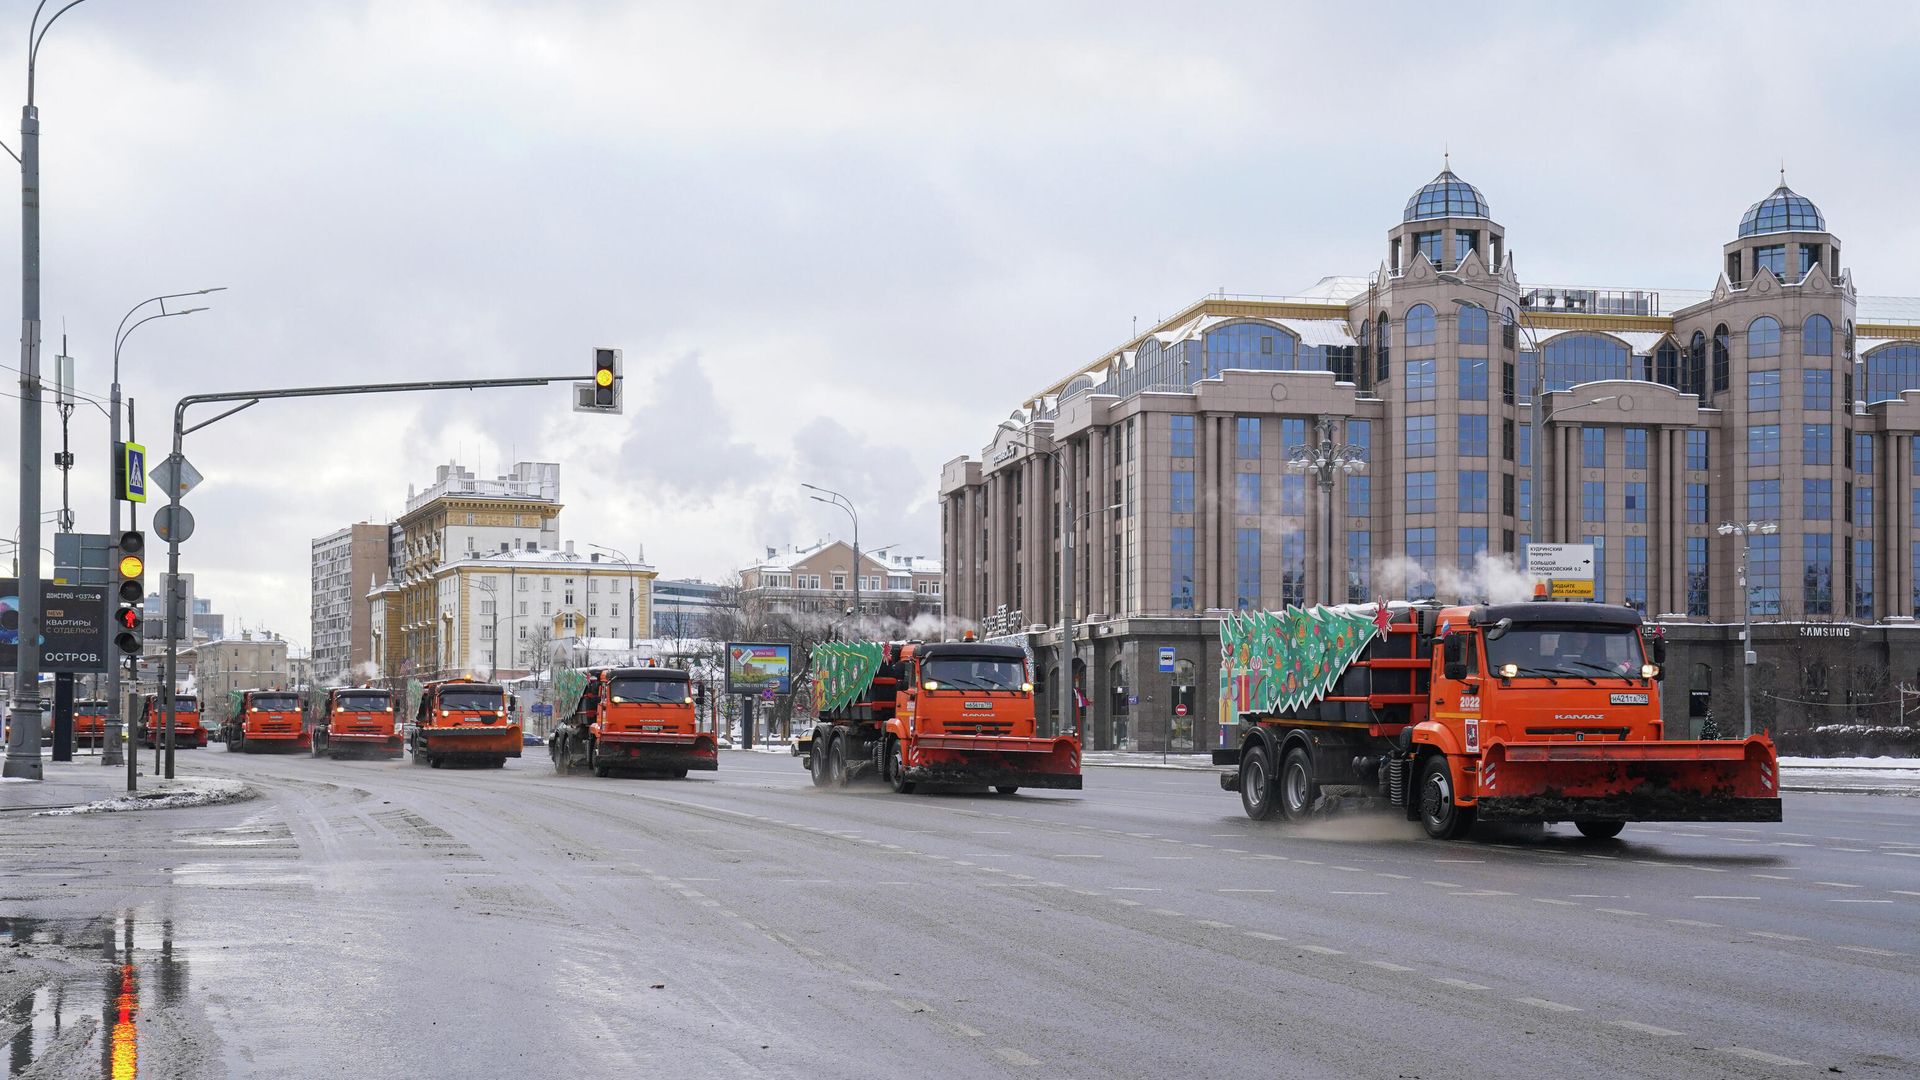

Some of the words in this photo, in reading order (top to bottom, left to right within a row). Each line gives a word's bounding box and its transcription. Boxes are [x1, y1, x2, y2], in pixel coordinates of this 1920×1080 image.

[45, 619, 91, 627] КВАРТИРЫ
[1800, 627, 1850, 637] SAMSUNG
[45, 652, 101, 662] ОСТРОВ.
[1460, 696, 1480, 708] 2022
